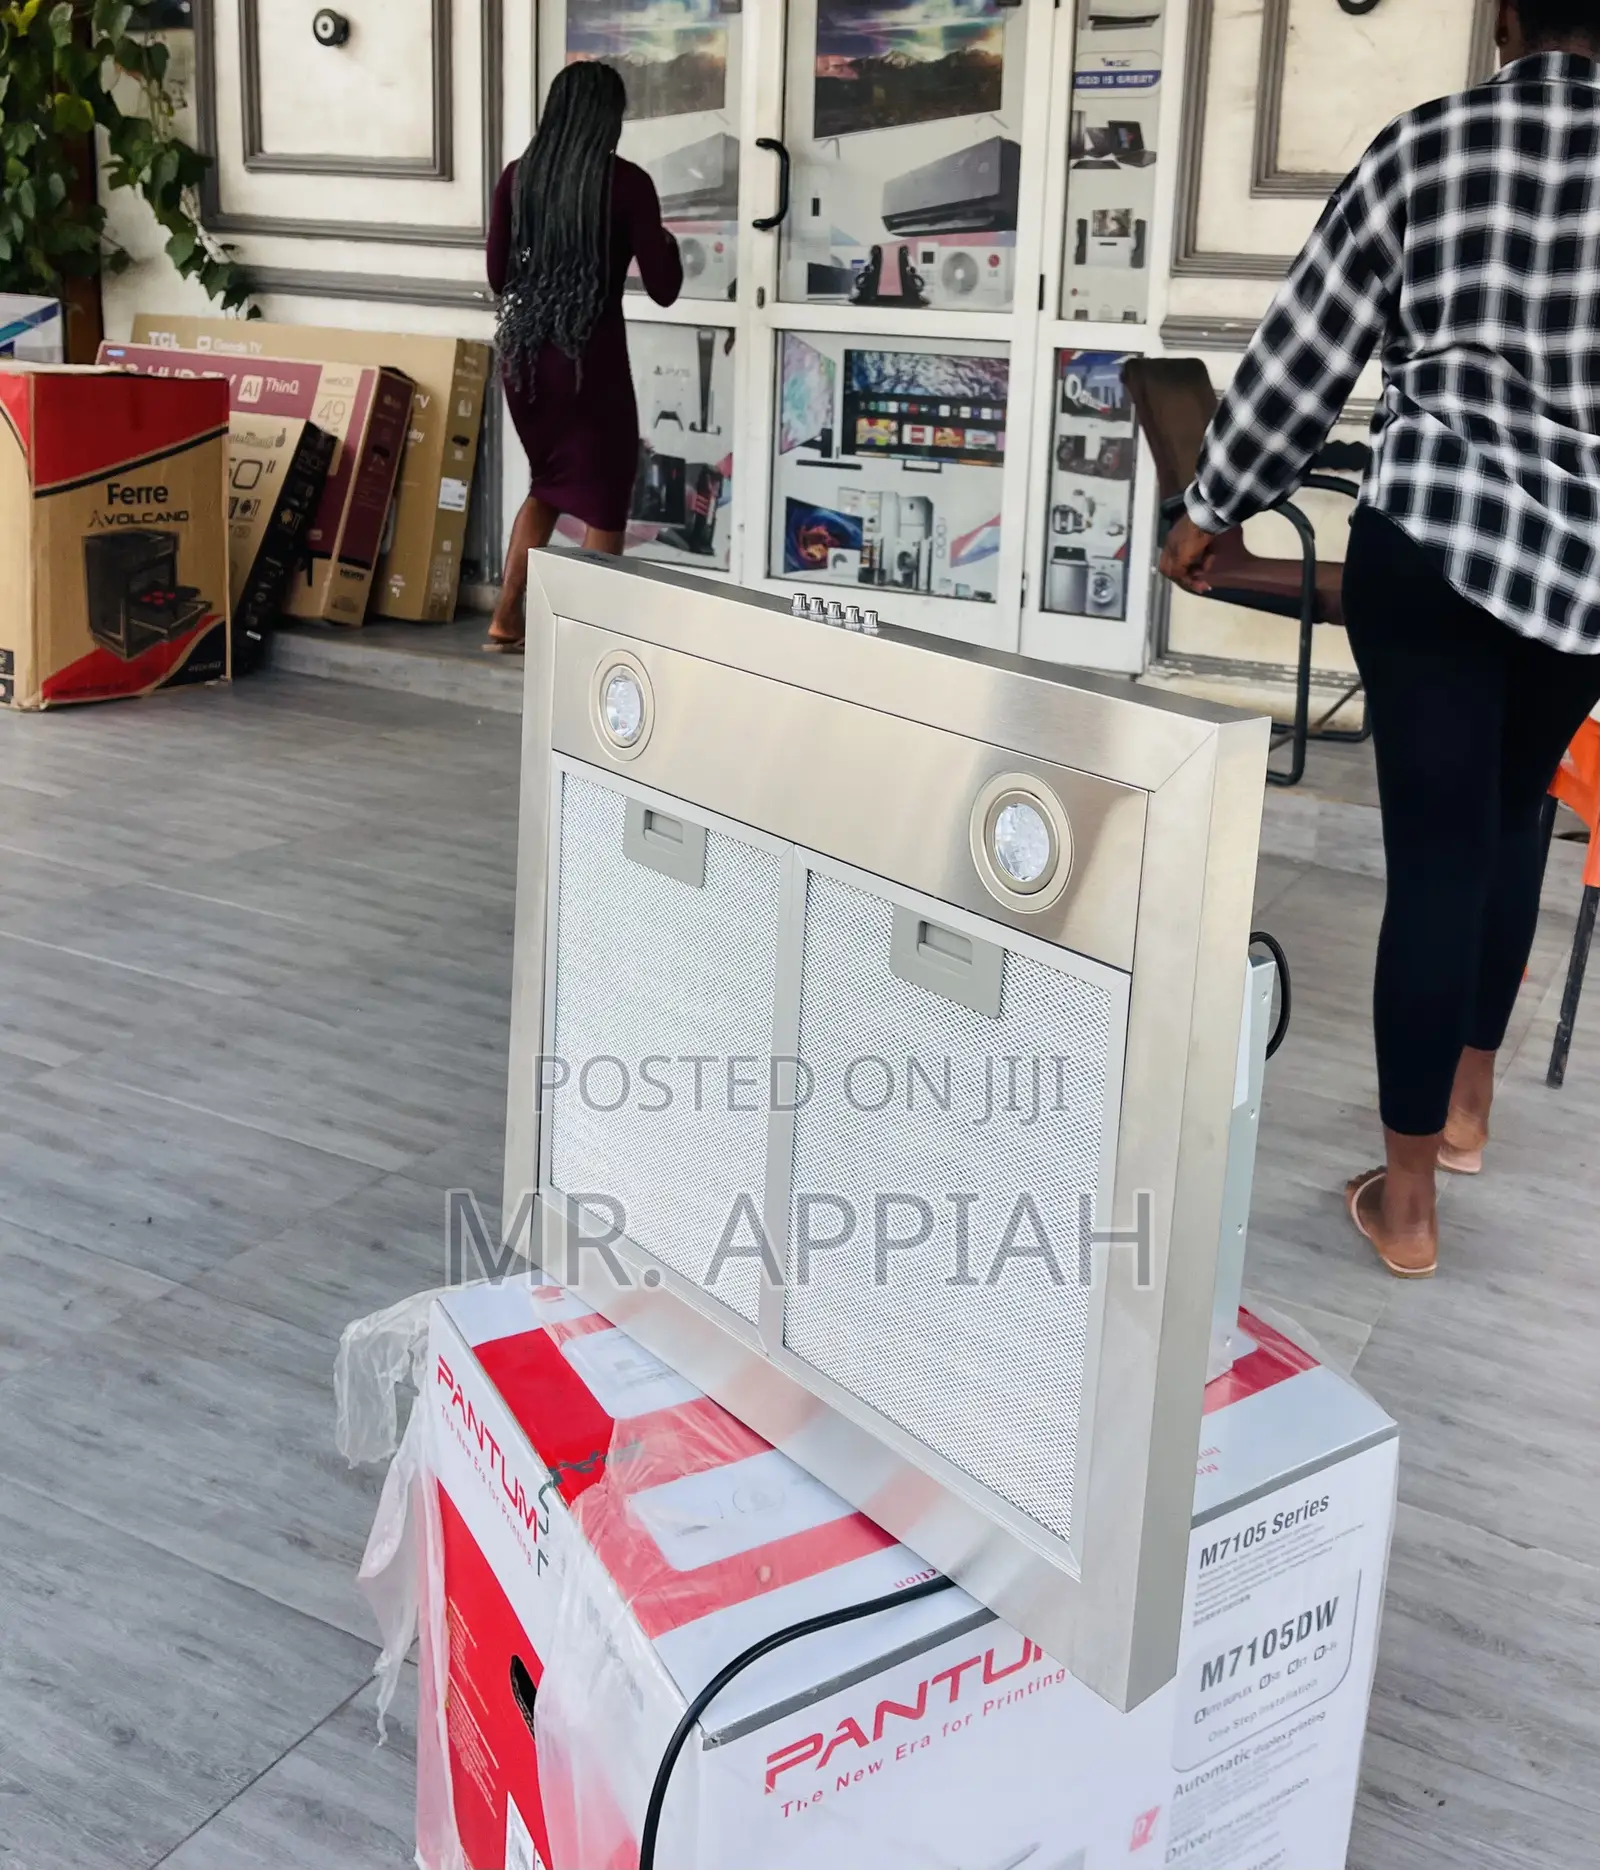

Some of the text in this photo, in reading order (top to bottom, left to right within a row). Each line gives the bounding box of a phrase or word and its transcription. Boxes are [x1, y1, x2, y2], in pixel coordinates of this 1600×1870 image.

[1102, 75, 1114, 84] IS
[148, 331, 180, 351] TCL
[242, 376, 300, 396] AI ThinQ
[317, 399, 346, 425] 49
[107, 483, 169, 505] Ferre
[104, 511, 189, 525] VOLCANO
[437, 1354, 538, 1544] PANTUM
[1200, 1520, 1267, 1570] M7105
[1271, 1495, 1330, 1536] Series
[1199, 1596, 1340, 1693] M7105DW
[780, 1668, 1067, 1819] The New Era for Printing
[1172, 1748, 1250, 1800] Automatic
[1164, 1828, 1215, 1864] Driver
